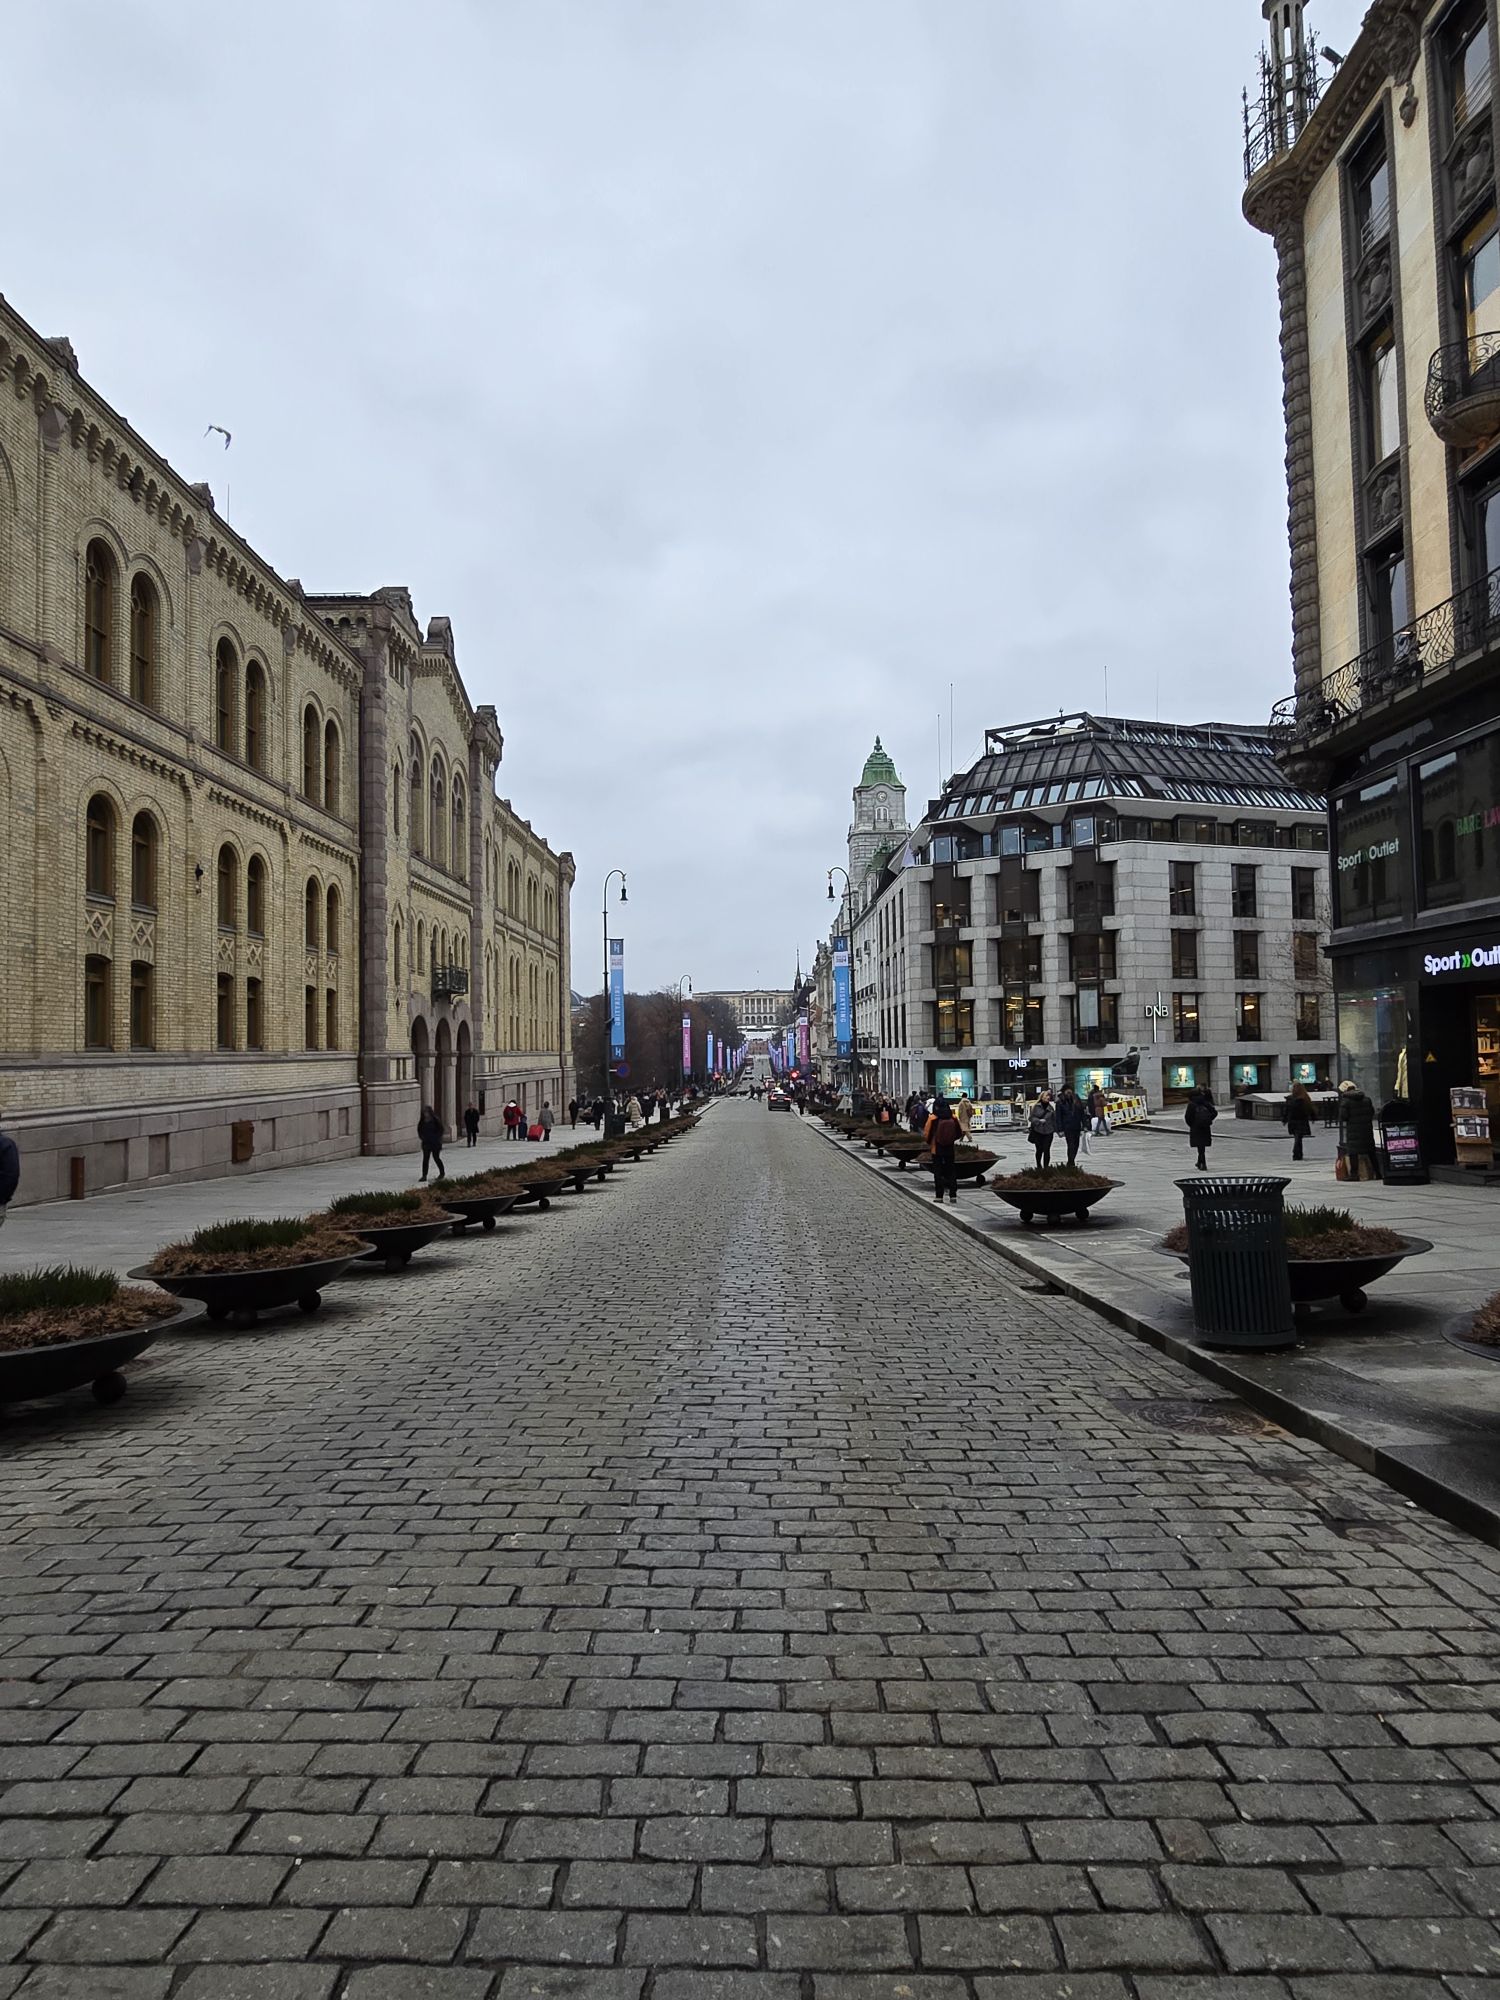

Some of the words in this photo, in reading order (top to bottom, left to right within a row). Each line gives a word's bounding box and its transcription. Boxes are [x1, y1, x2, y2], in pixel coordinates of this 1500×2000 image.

[1456, 813, 1481, 836] BARE
[1337, 850, 1361, 871] Sport
[1369, 838, 1399, 860] Outlet
[1424, 951, 1460, 976] Sport
[839, 982, 847, 1023] SKISKYTING
